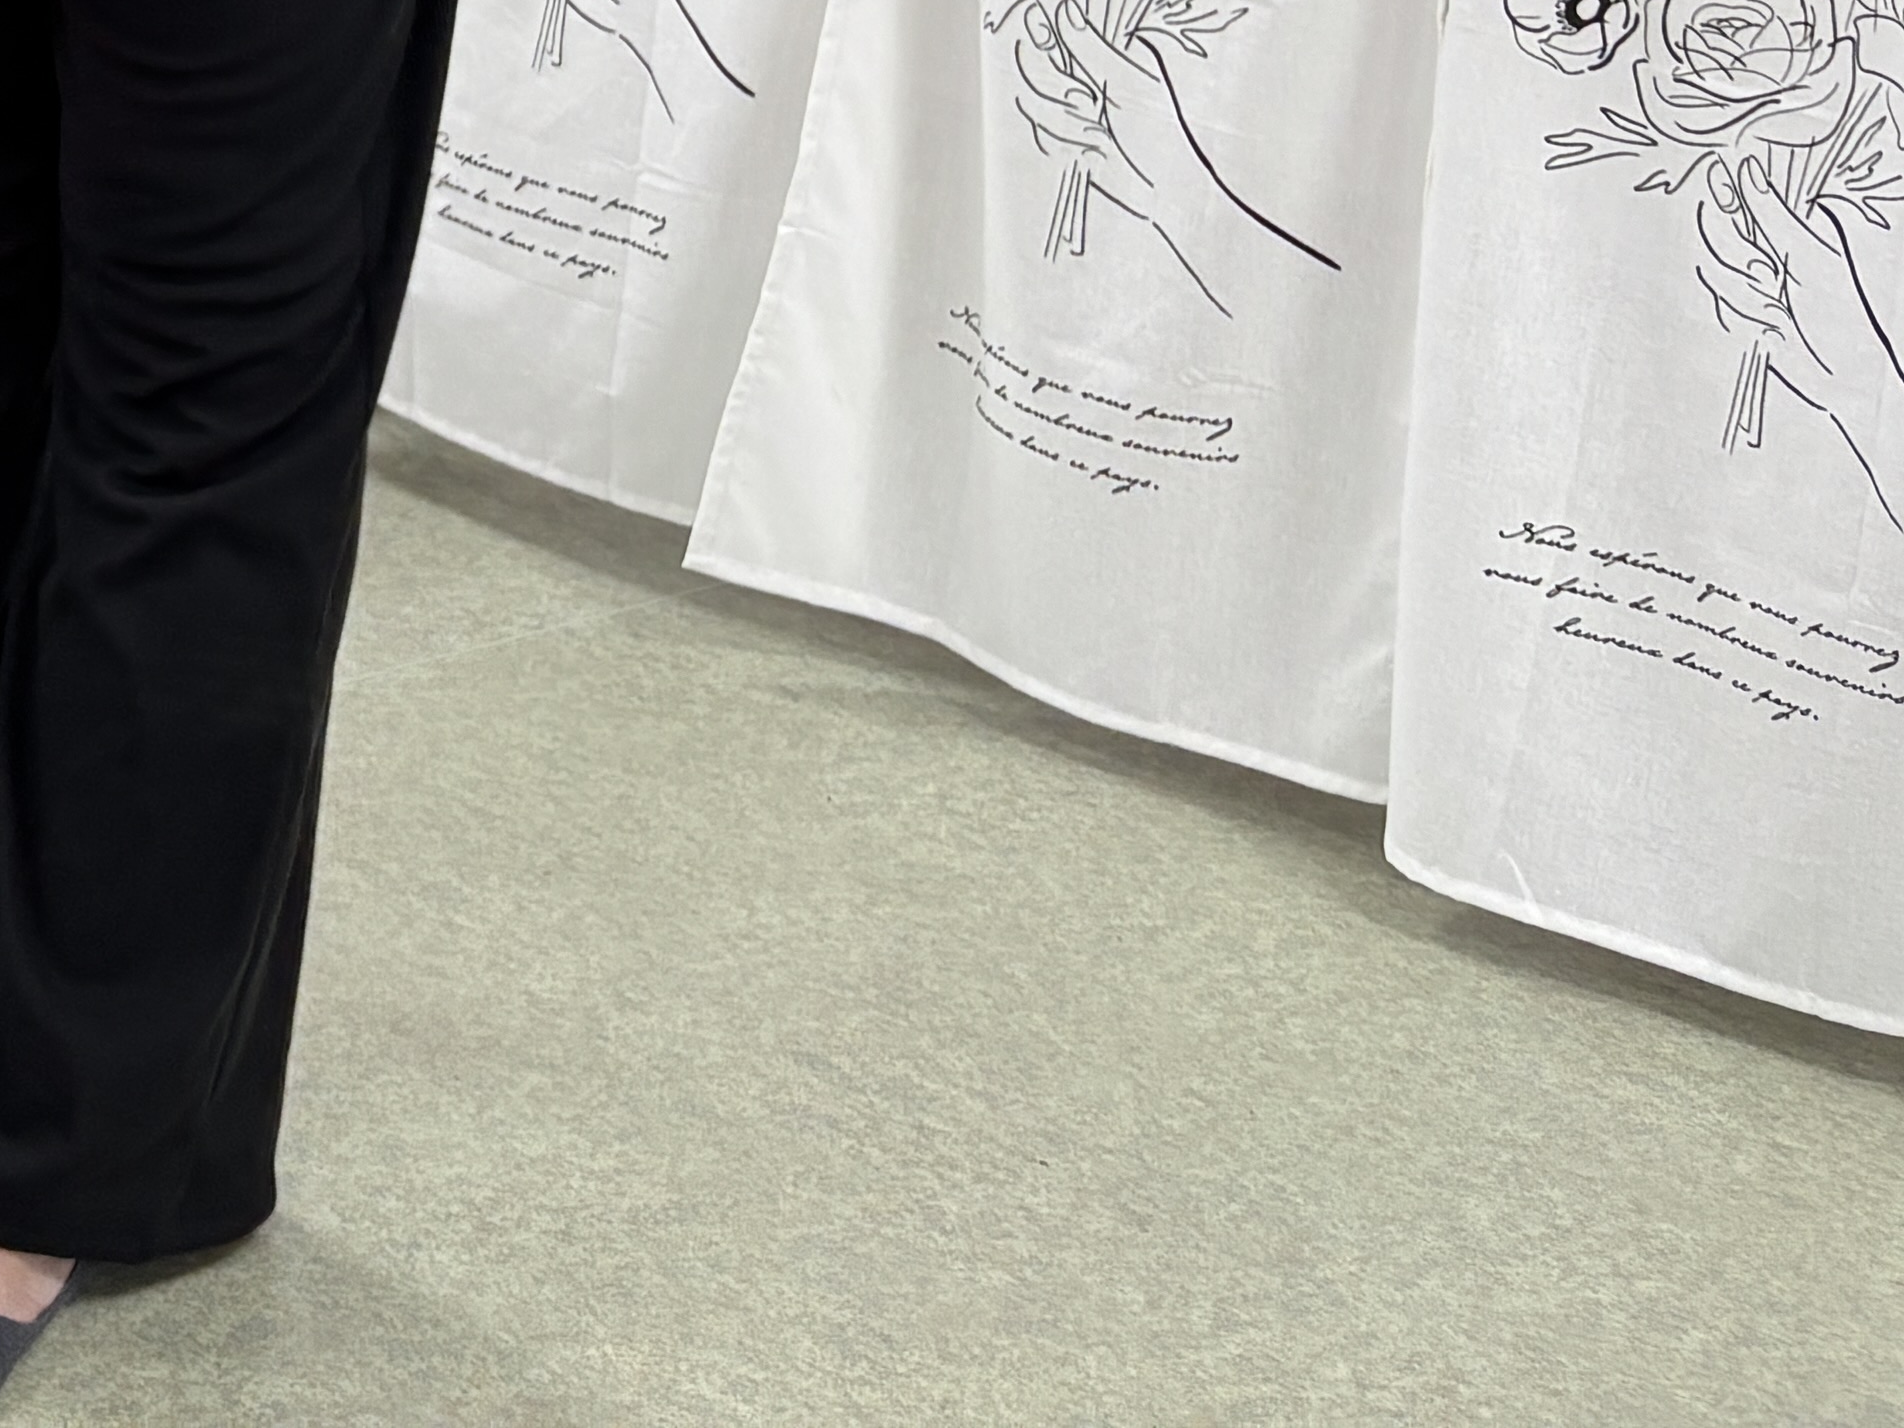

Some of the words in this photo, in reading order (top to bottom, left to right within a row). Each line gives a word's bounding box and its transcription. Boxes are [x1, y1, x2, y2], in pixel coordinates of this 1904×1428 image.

[1499, 522, 1576, 552] Nous
[1590, 549, 1695, 583] espérons
[1697, 583, 1741, 602] que
[1800, 623, 1900, 673] pourrez
[1547, 576, 1618, 604] faire
[1629, 596, 1657, 614] de
[1666, 613, 1778, 660] nombreux
[1553, 616, 1663, 659] heureux
[1673, 652, 1722, 680] dans
[1752, 689, 1819, 722] pays.
